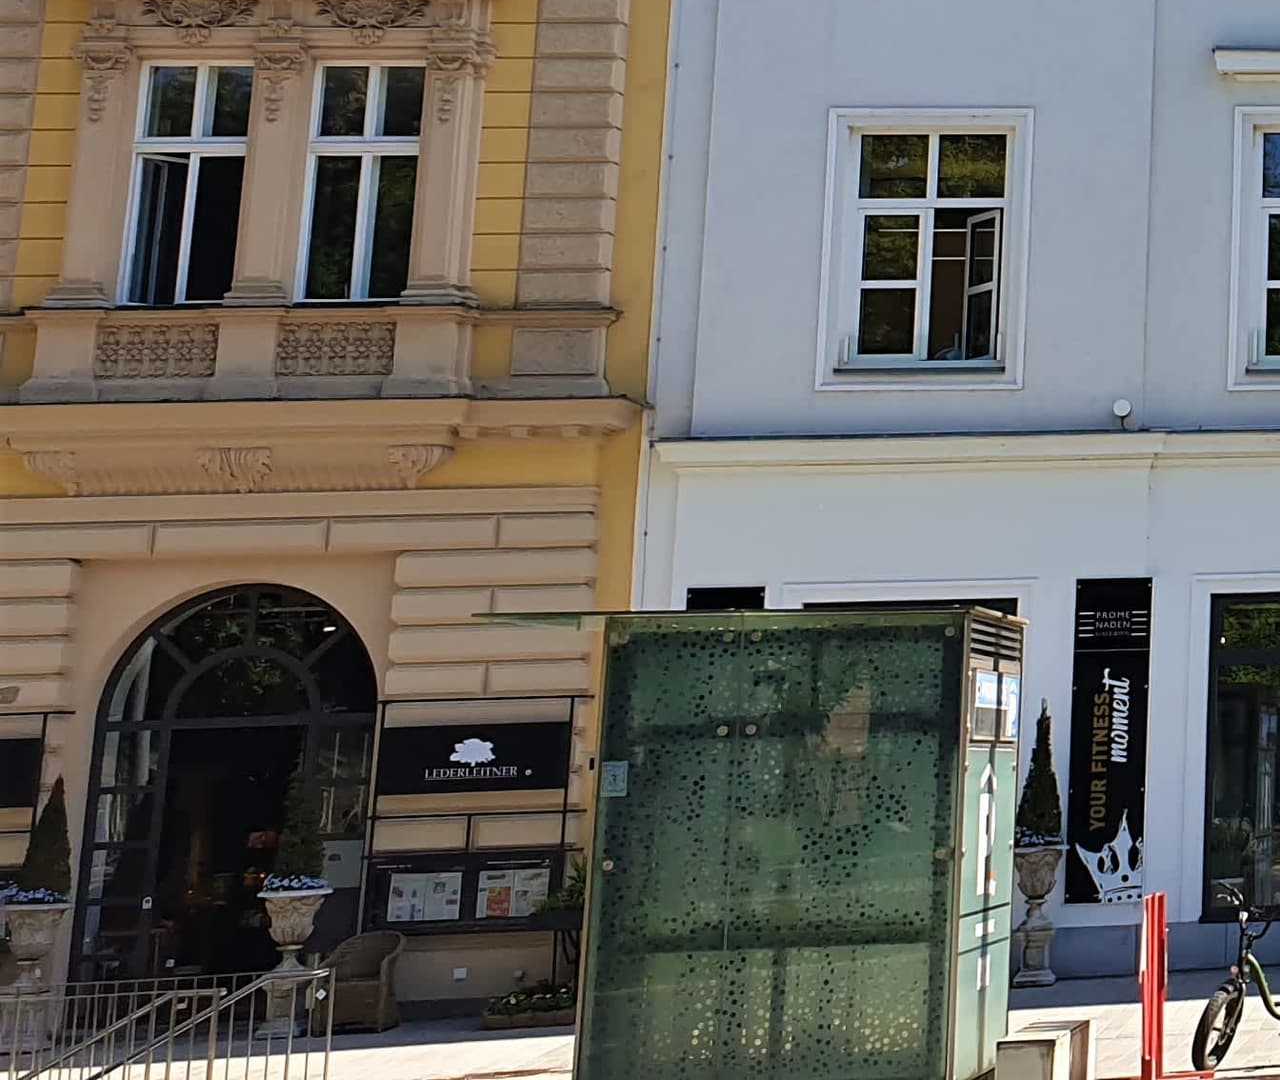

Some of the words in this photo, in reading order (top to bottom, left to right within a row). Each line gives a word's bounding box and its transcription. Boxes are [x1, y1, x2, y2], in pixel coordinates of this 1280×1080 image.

[1095, 620, 1131, 629] NADEN
[1091, 691, 1111, 773] FITNESS
[1101, 667, 1131, 763] moment
[424, 765, 518, 780] LEDERLEITNER
[1089, 778, 1107, 832] YOUR
